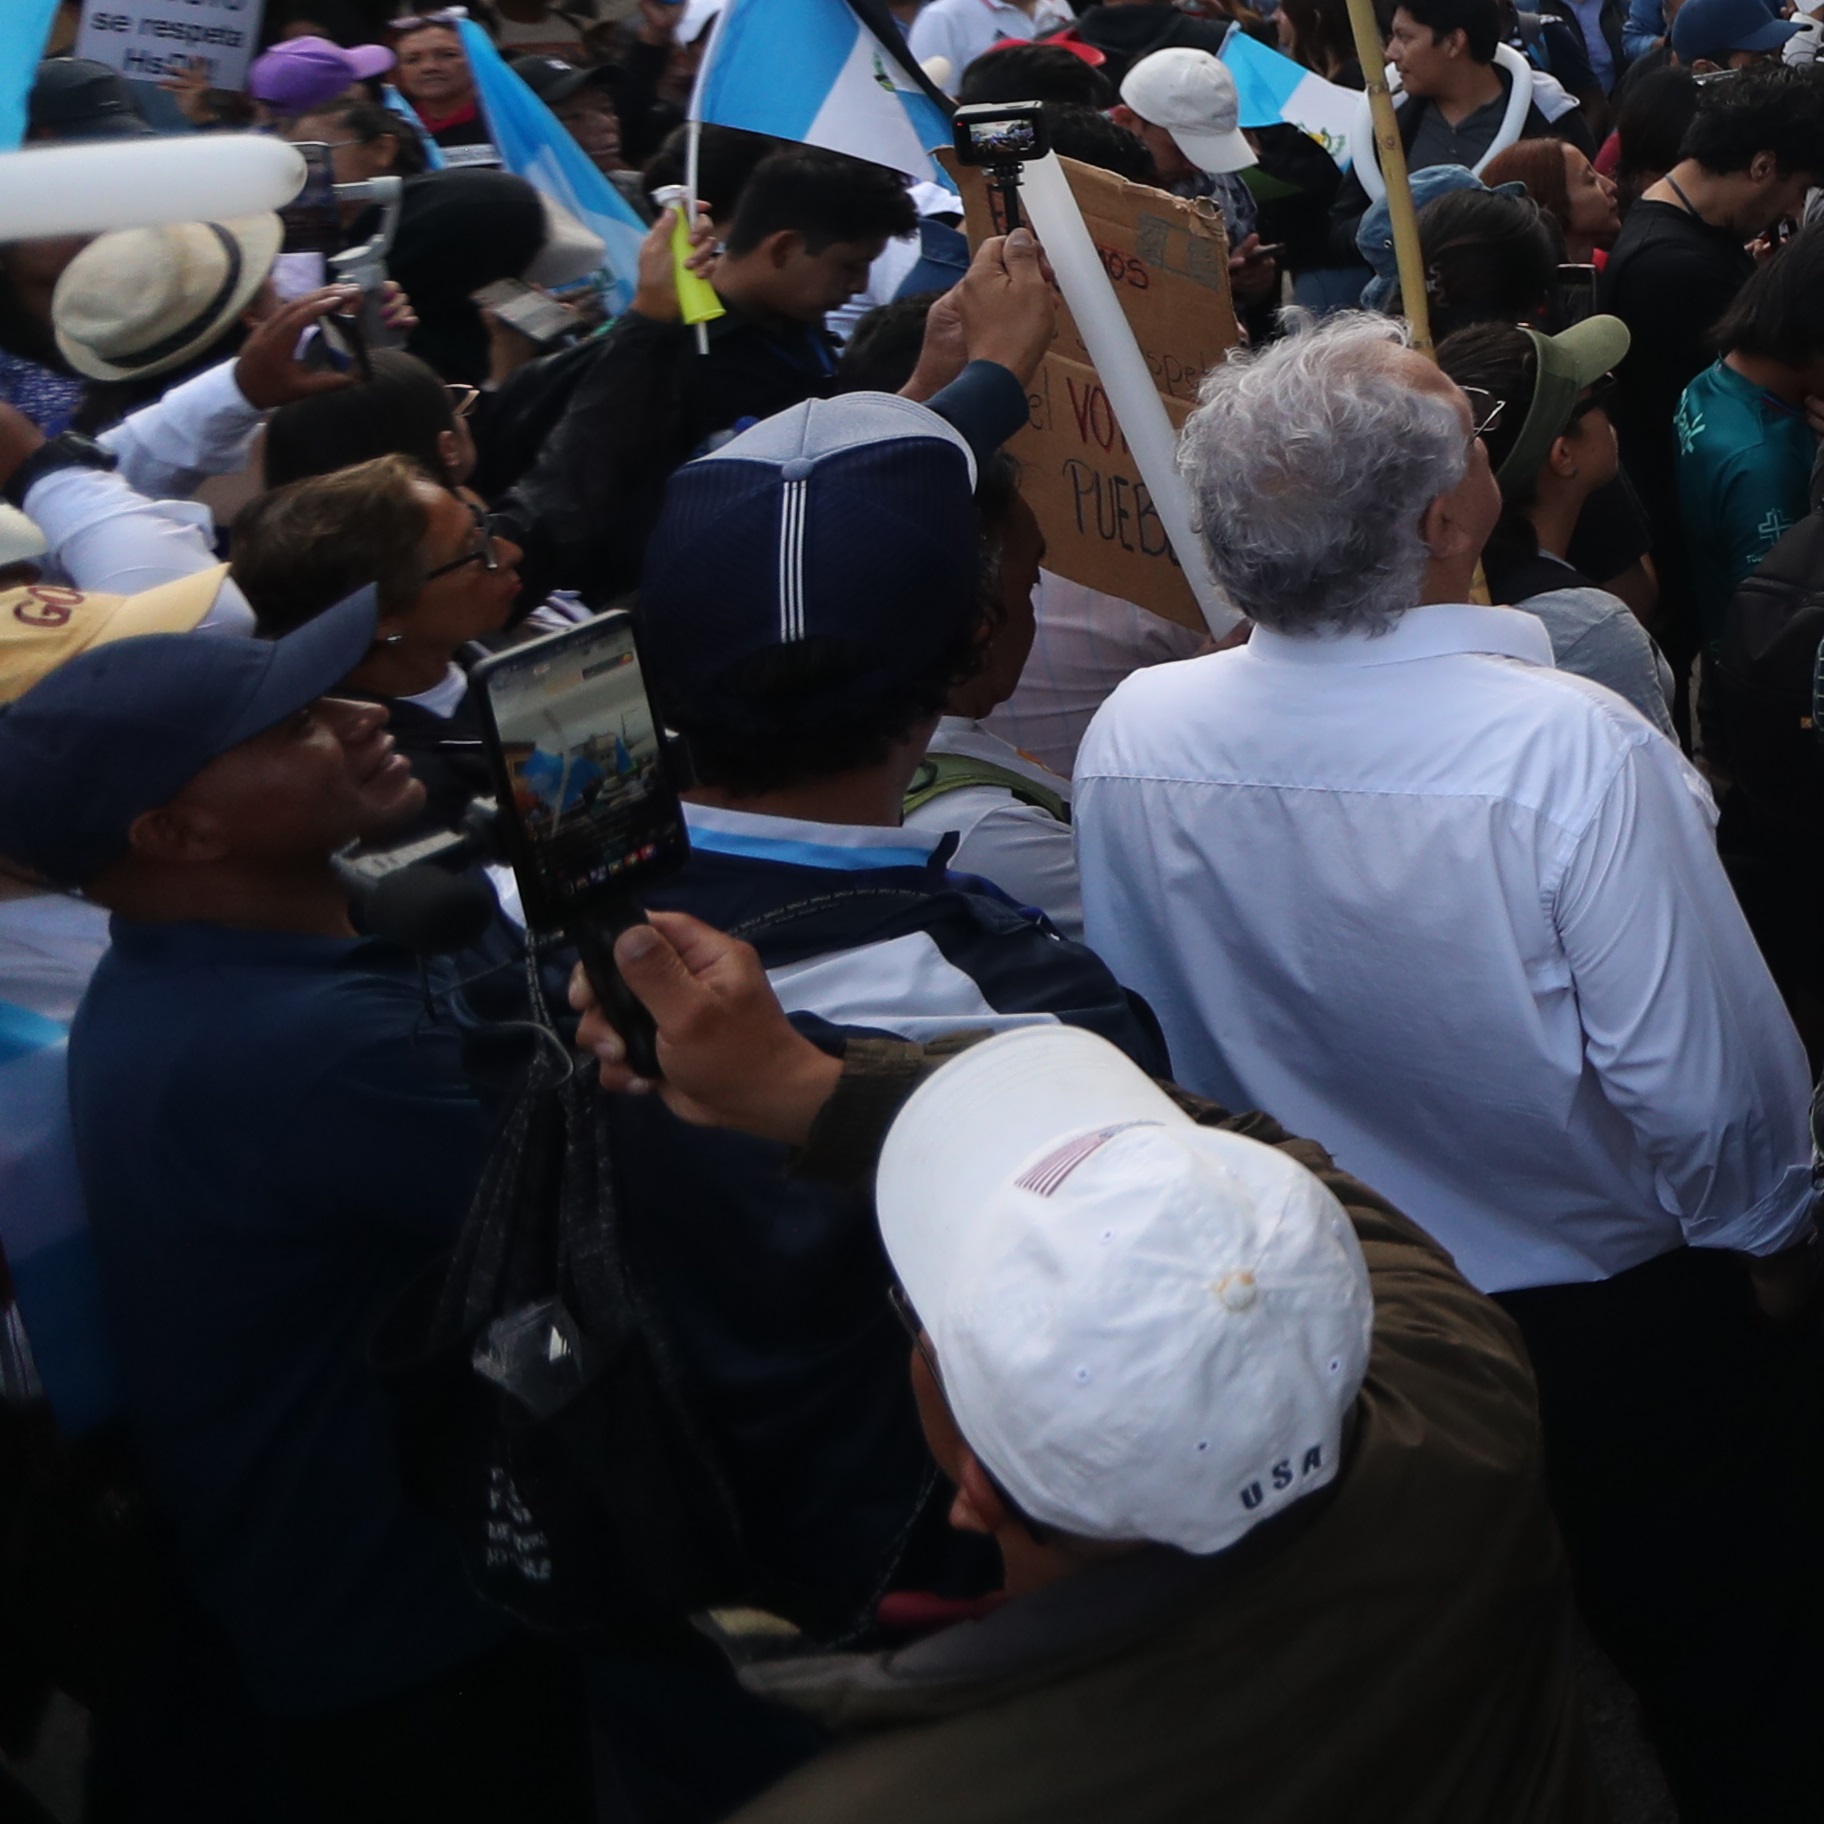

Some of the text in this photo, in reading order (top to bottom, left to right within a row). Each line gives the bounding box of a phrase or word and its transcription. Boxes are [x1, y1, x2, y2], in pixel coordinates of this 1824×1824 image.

[92, 12, 245, 48] se respeta
[1241, 1445, 1323, 1511] USA
